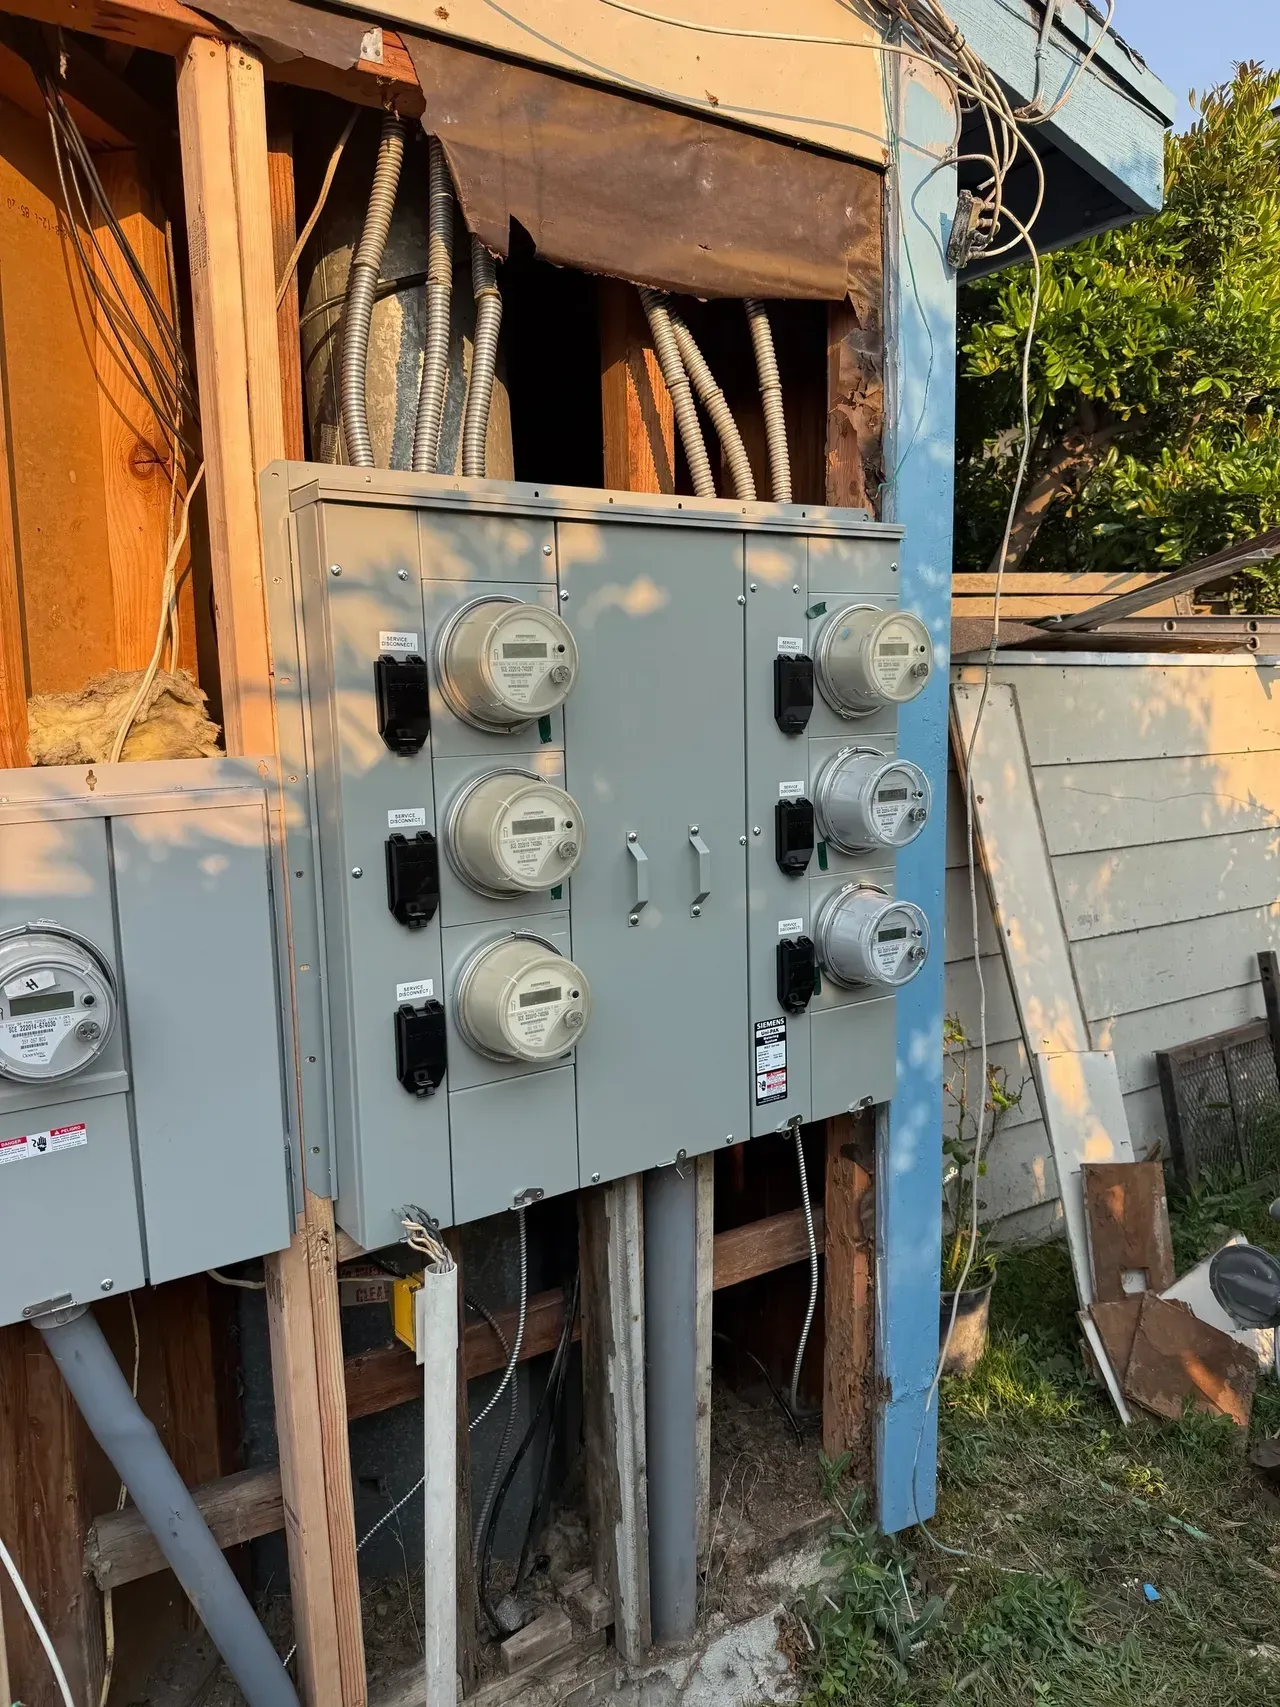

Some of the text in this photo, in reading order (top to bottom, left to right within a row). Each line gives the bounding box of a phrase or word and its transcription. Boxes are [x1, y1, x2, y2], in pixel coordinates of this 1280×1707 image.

[398, 989, 429, 997] DISCONNECT
[756, 1017, 785, 1030] SIEMENS
[8, 1025, 18, 1034] SCE
[60, 1125, 81, 1133] PELIGRO
[1, 1139, 21, 1147] DANGER
